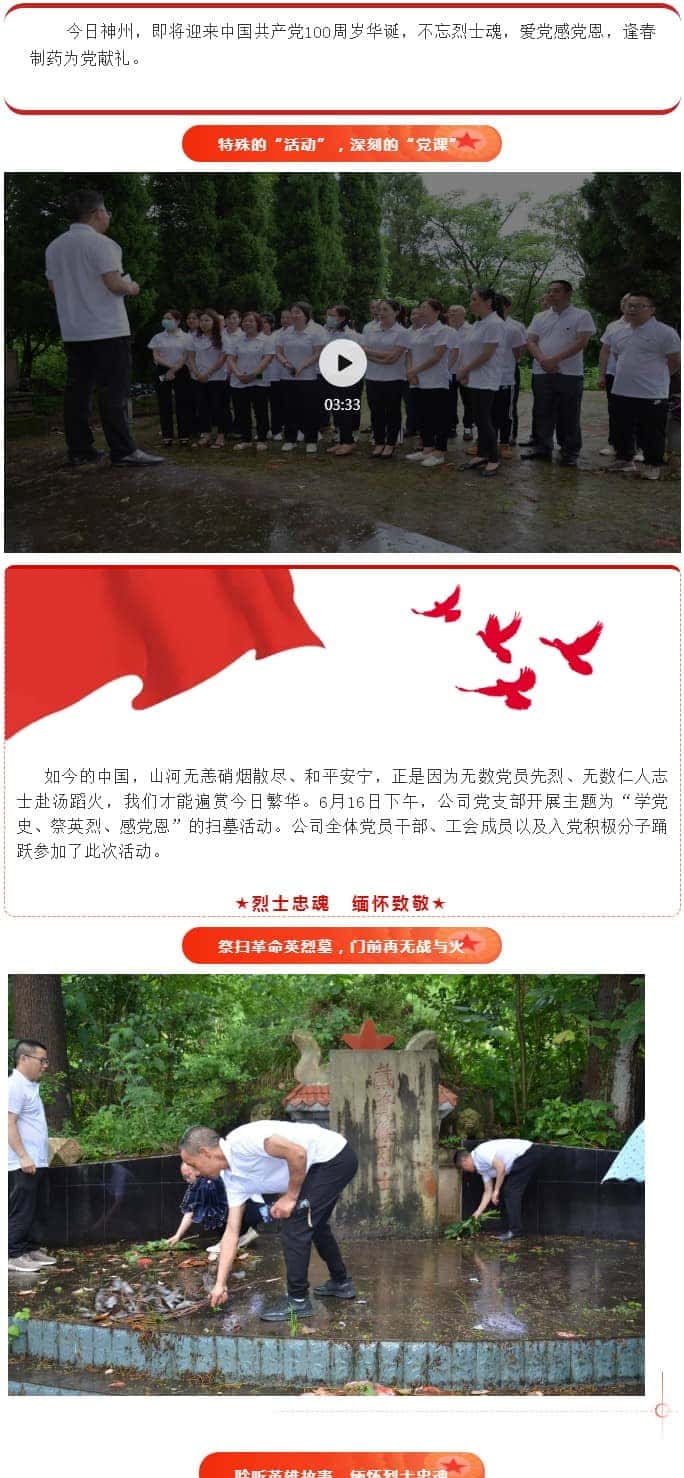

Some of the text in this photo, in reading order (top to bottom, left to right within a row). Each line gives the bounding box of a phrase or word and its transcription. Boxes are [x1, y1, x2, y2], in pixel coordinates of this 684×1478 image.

[29, 49, 141, 67] 制药为党献礼。
[16, 842, 161, 860] 跃参加了此次活动。
[252, 895, 429, 912] 烈士忠魂 缅怀致敬
[217, 939, 465, 955] 祭扫革命英烈墓，门前再无战与火
